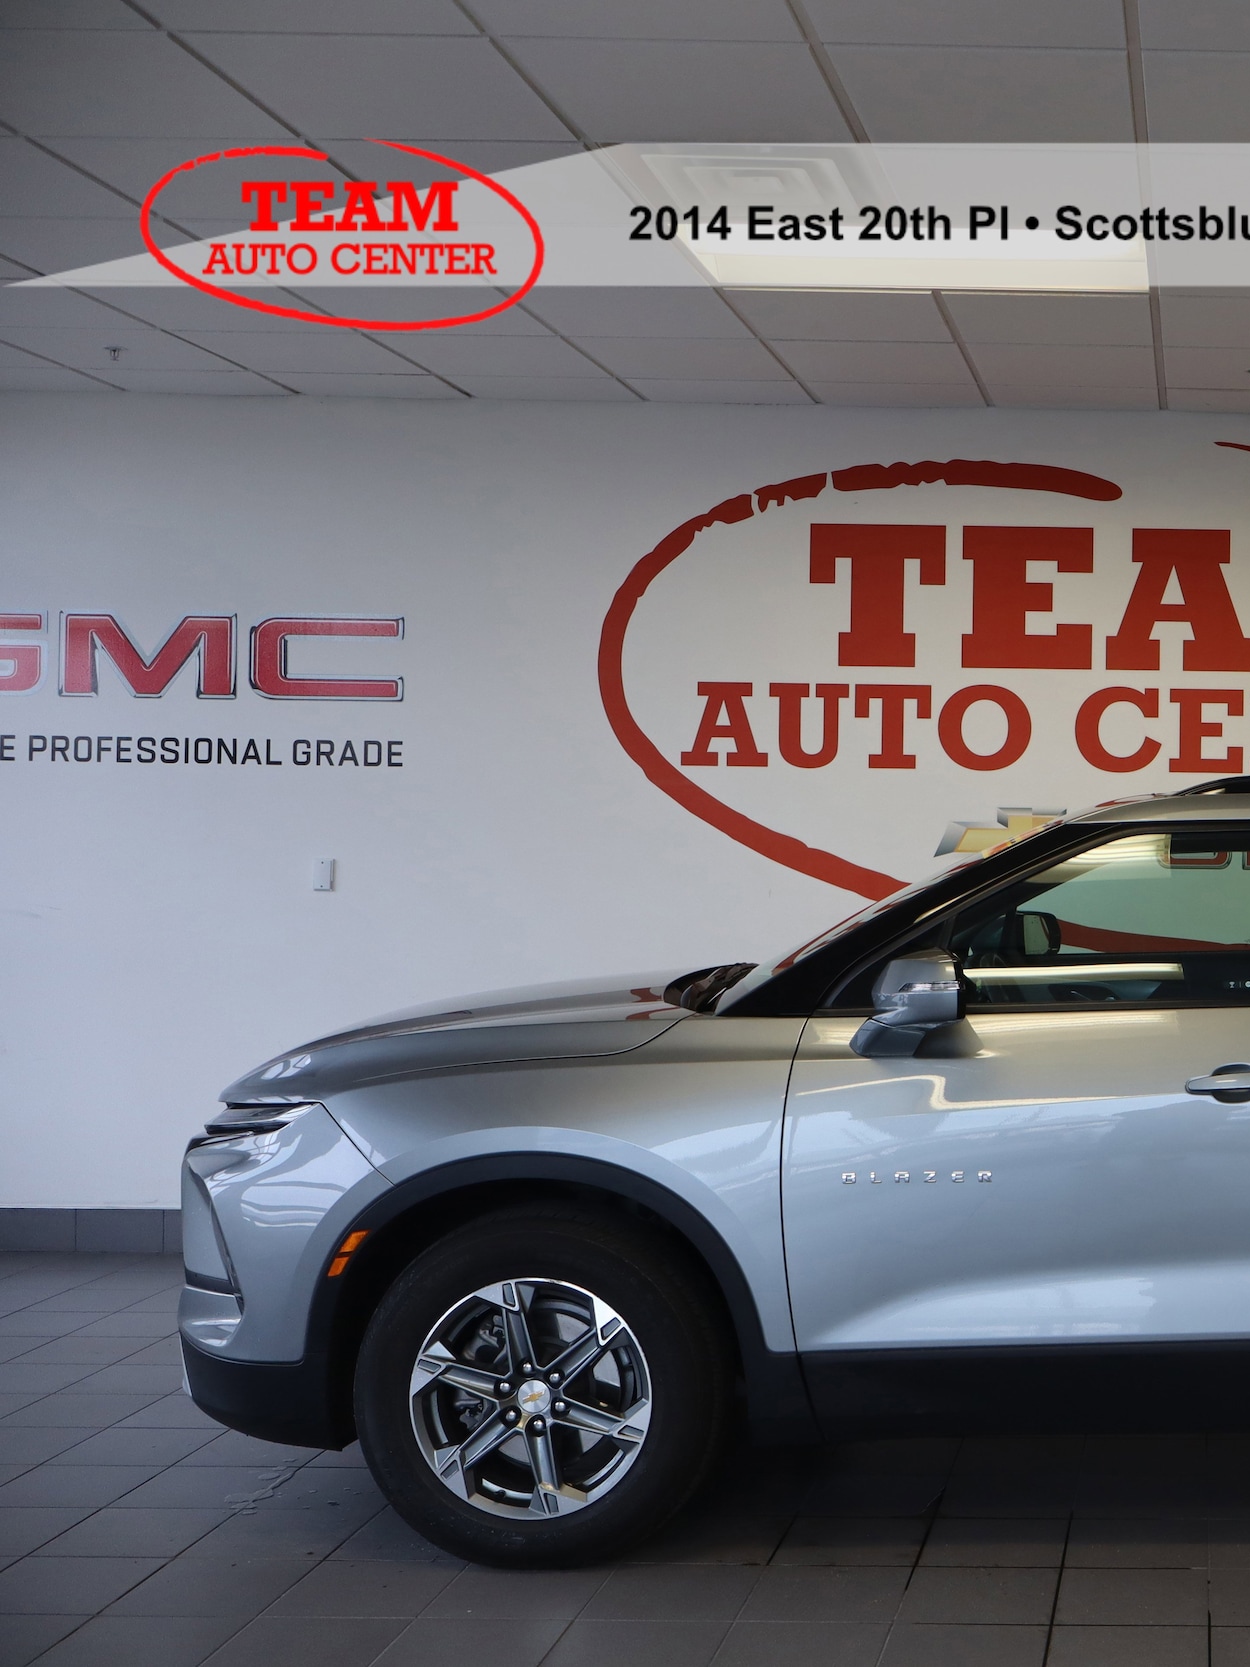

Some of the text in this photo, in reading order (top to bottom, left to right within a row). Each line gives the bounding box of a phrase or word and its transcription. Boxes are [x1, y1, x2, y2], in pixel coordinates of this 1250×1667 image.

[680, 681, 1033, 772] AUTO
[28, 735, 283, 766] PROFESSIONAL
[292, 739, 404, 767] GRADE
[841, 1170, 993, 1185] BLAZER
